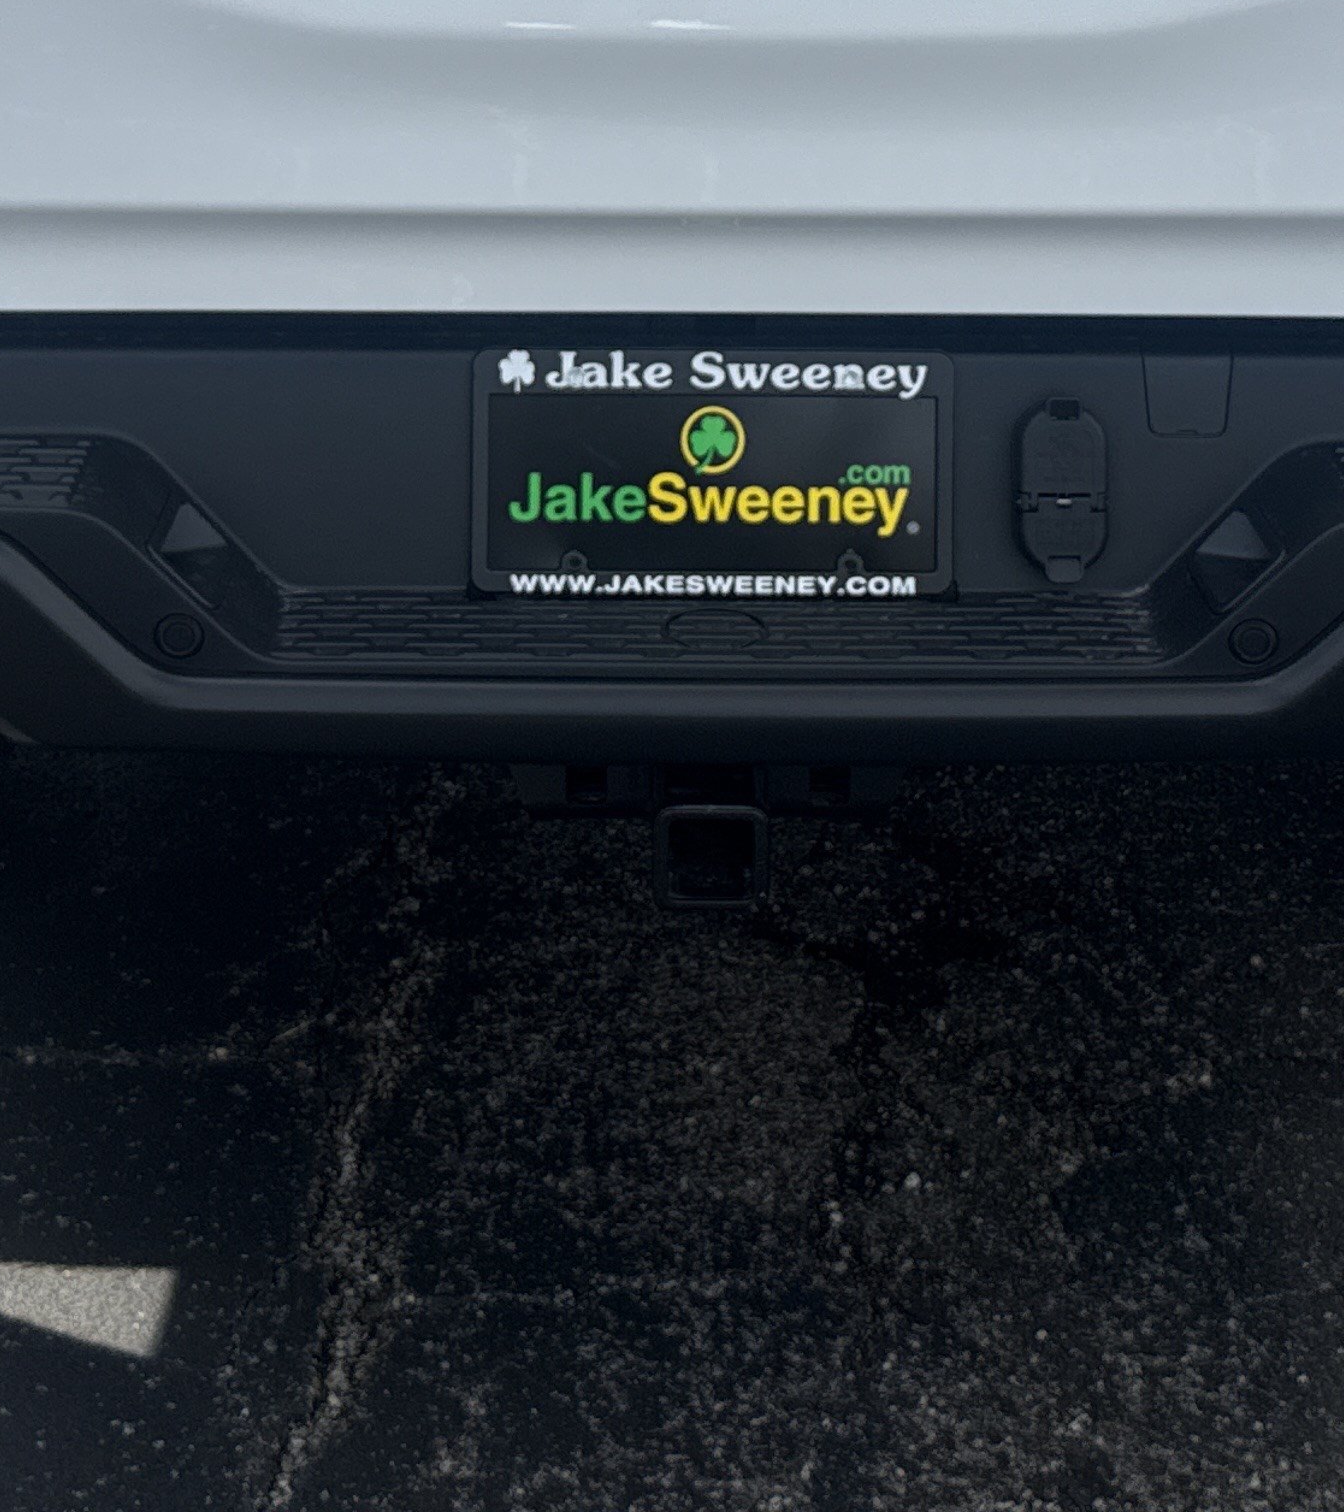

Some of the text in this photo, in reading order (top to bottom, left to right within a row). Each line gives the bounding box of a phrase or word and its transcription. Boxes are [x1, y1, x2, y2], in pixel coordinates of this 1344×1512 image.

[545, 350, 928, 401] Jake Sweeney
[509, 574, 917, 597] WWW.JAKESWEENEY.COM
